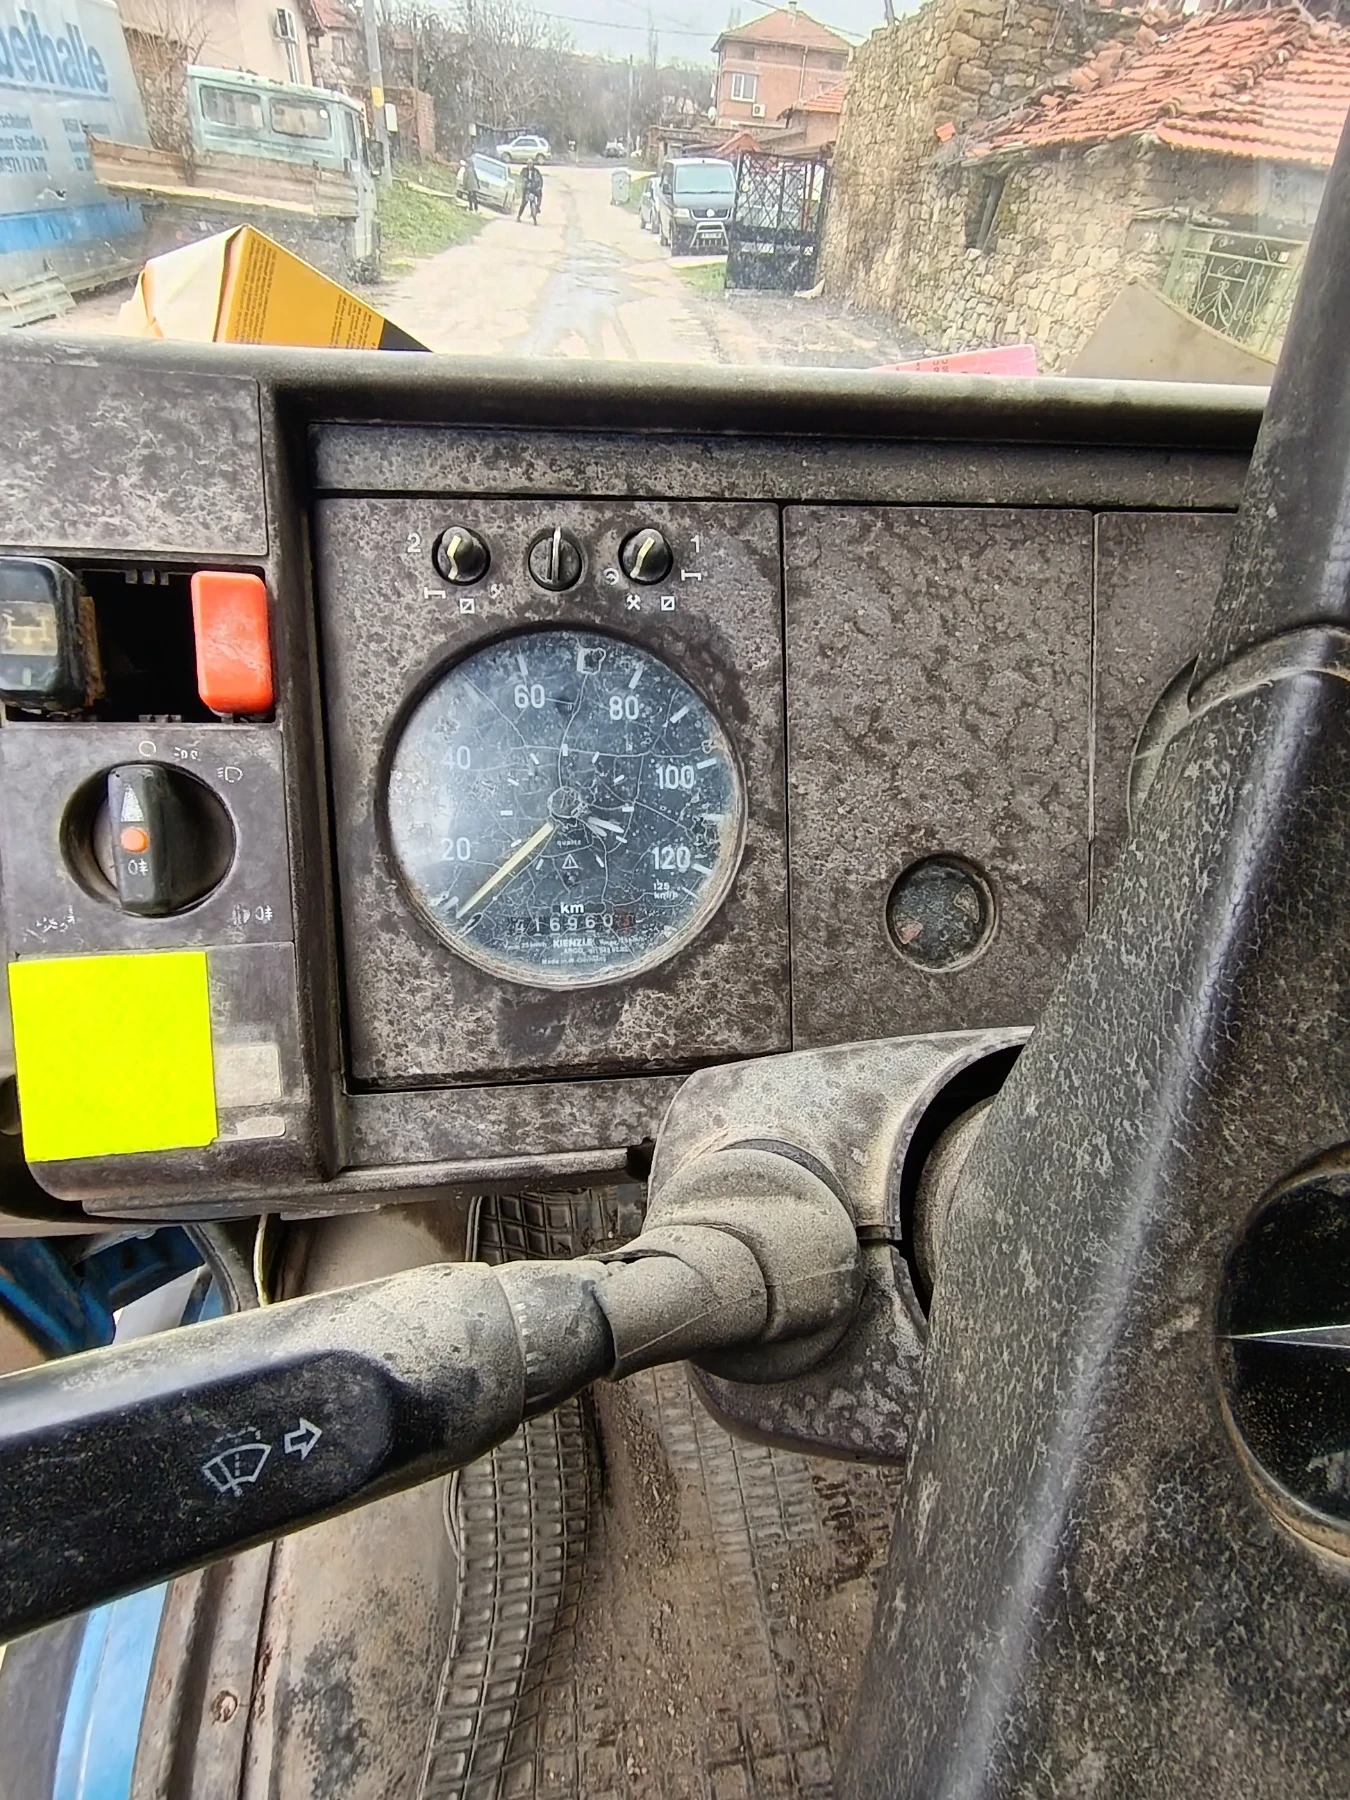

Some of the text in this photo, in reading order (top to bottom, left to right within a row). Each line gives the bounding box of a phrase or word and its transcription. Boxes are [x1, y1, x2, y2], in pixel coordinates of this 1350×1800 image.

[406, 533, 421, 553] 2
[690, 534, 700, 554] 1
[513, 683, 546, 709] 60
[609, 695, 639, 720] 80
[442, 745, 471, 770] 40
[656, 764, 695, 790] 100
[441, 836, 471, 861] 20
[651, 845, 691, 871] 120
[560, 901, 585, 914] km
[552, 938, 594, 949] KIENZLE
